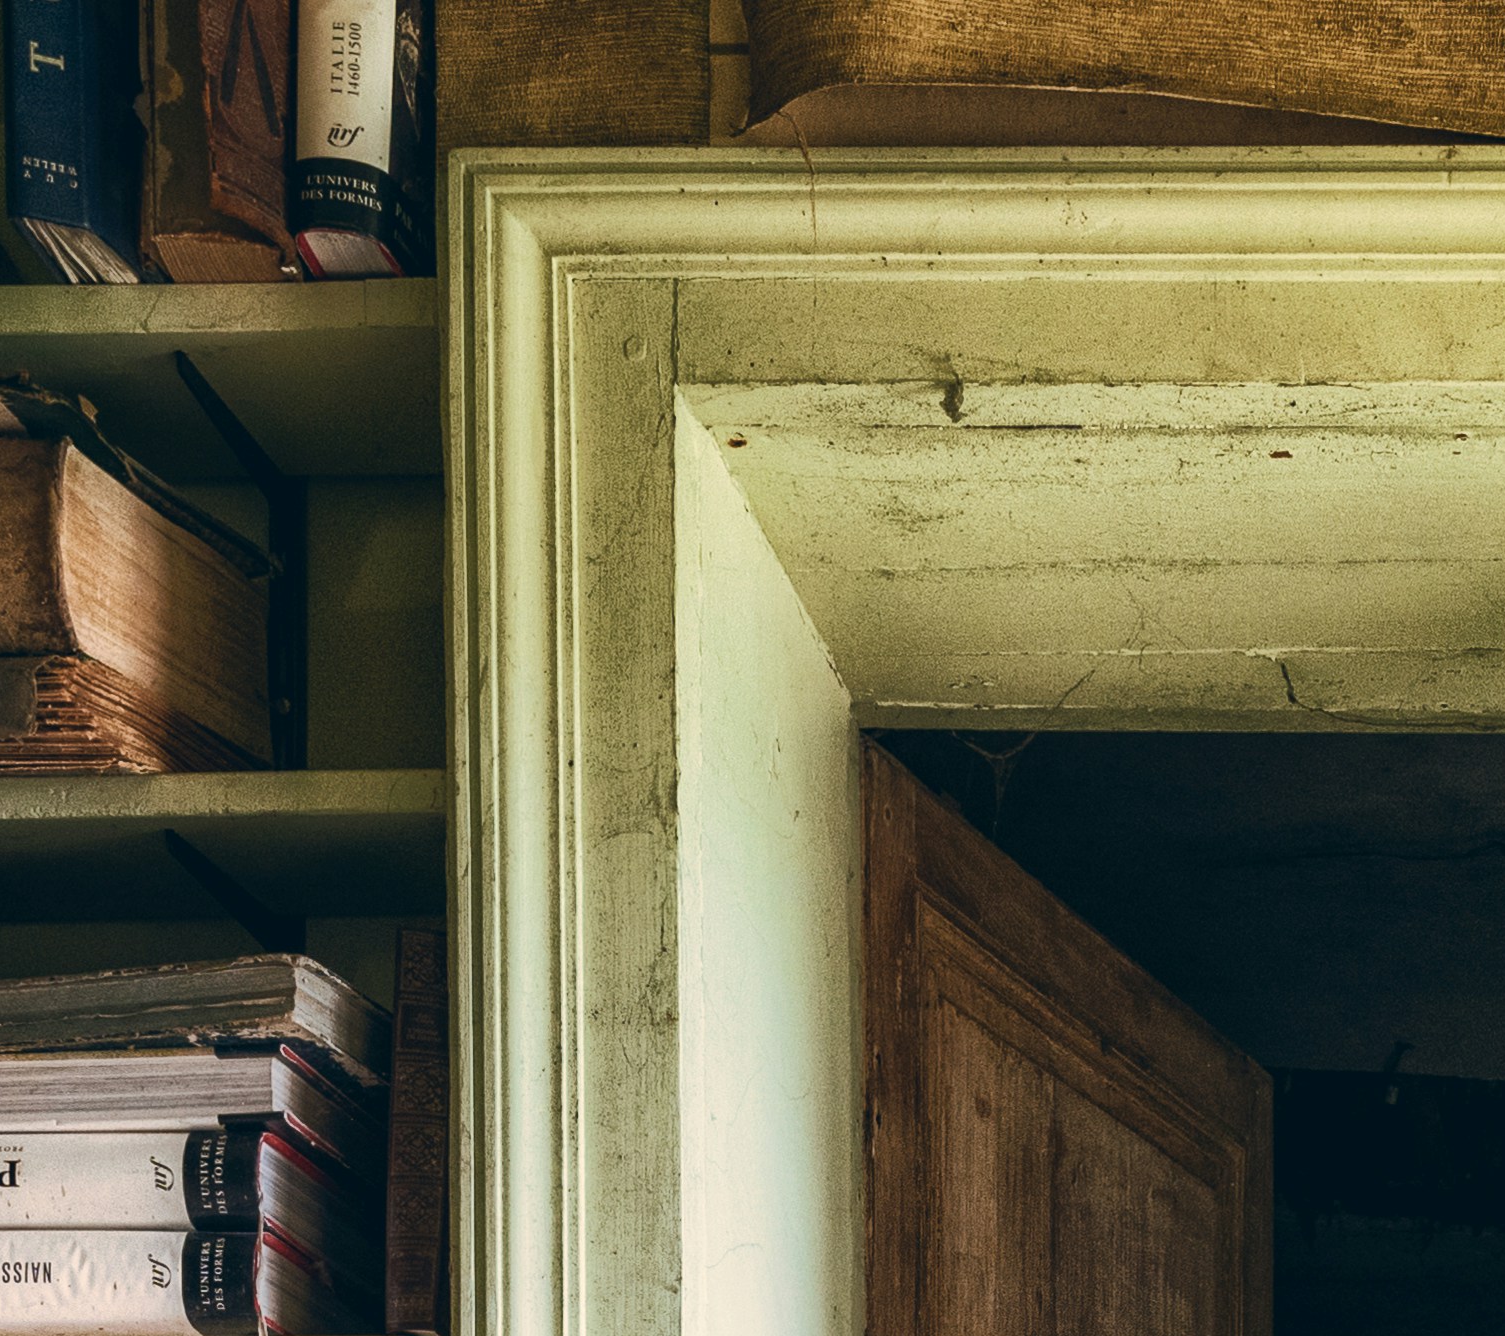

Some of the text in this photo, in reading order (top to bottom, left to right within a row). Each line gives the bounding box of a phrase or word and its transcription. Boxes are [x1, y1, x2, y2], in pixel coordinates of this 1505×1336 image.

[330, 21, 345, 95] ITALIE
[348, 22, 362, 97] 1460-1500
[301, 174, 383, 212] L'UNIVERS DES FORMES
